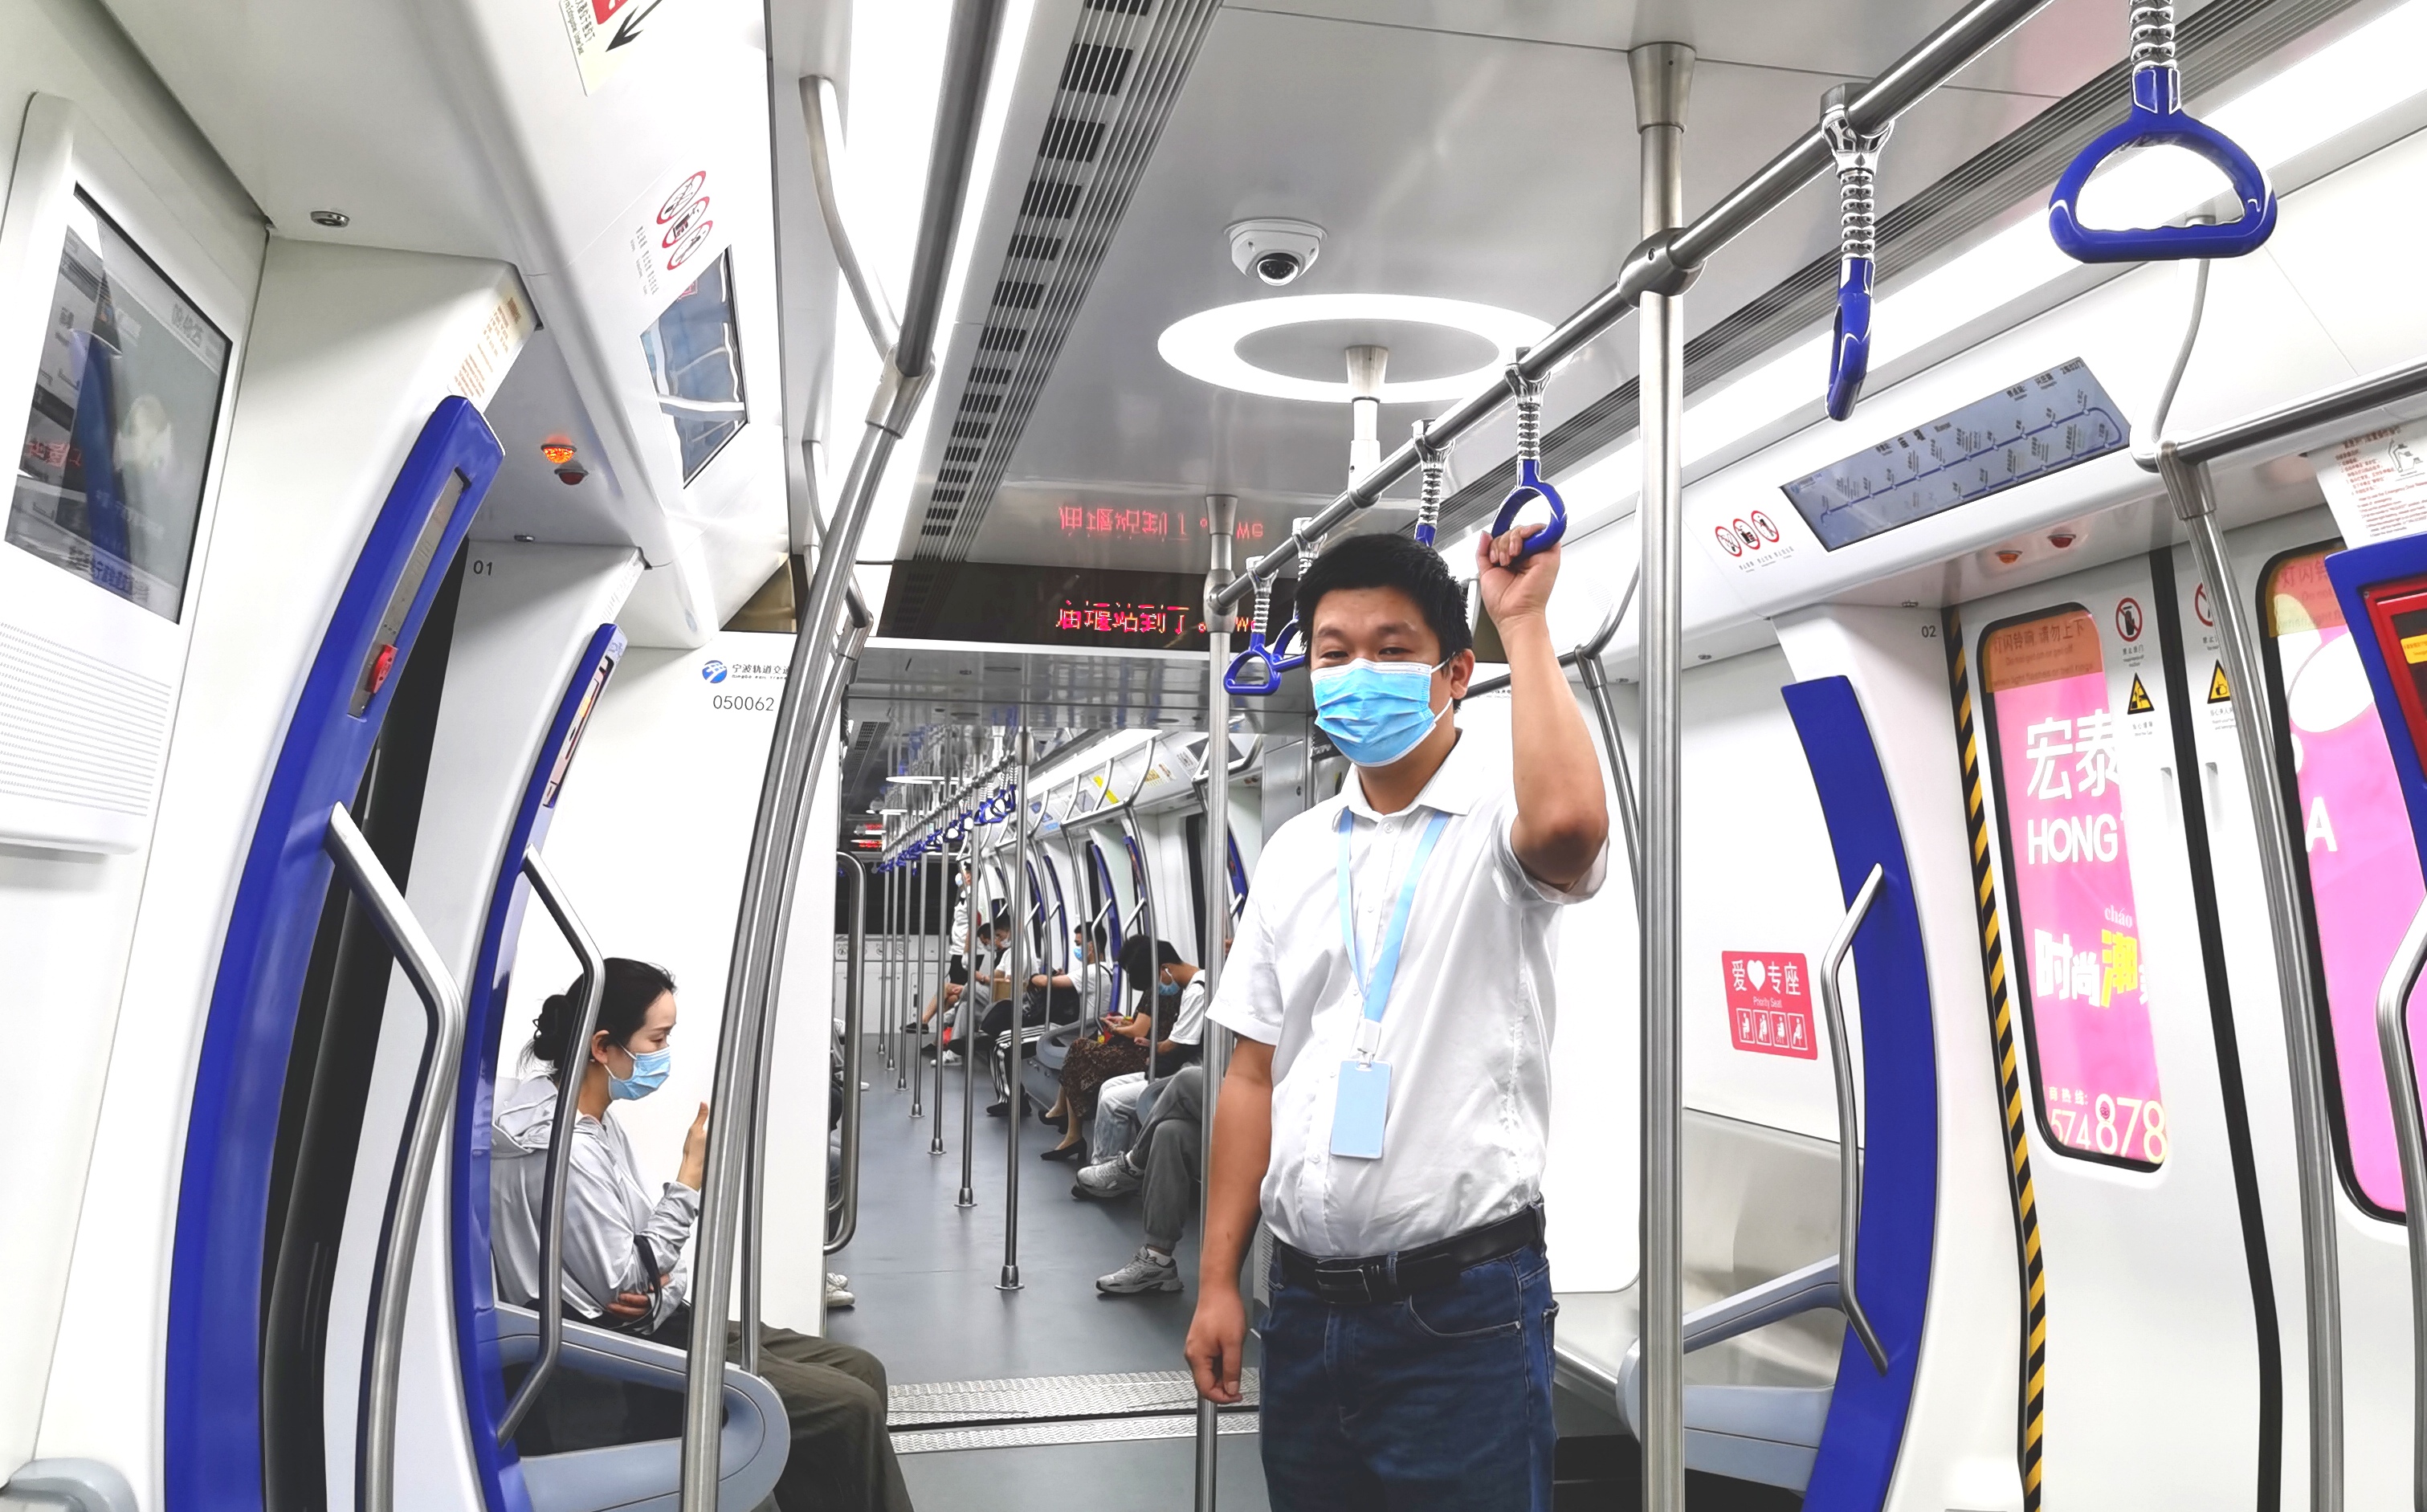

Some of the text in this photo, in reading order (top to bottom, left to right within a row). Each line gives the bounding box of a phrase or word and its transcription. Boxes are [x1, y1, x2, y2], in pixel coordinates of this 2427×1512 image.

[473, 560, 492, 577] 01
[1921, 625, 1937, 638] 02
[713, 695, 774, 711] 050062
[2026, 708, 2120, 800] 宏泰
[2028, 813, 2119, 865] HONG
[2034, 928, 2148, 1009] 时尚潮
[1753, 996, 1783, 1009] Priority Seat
